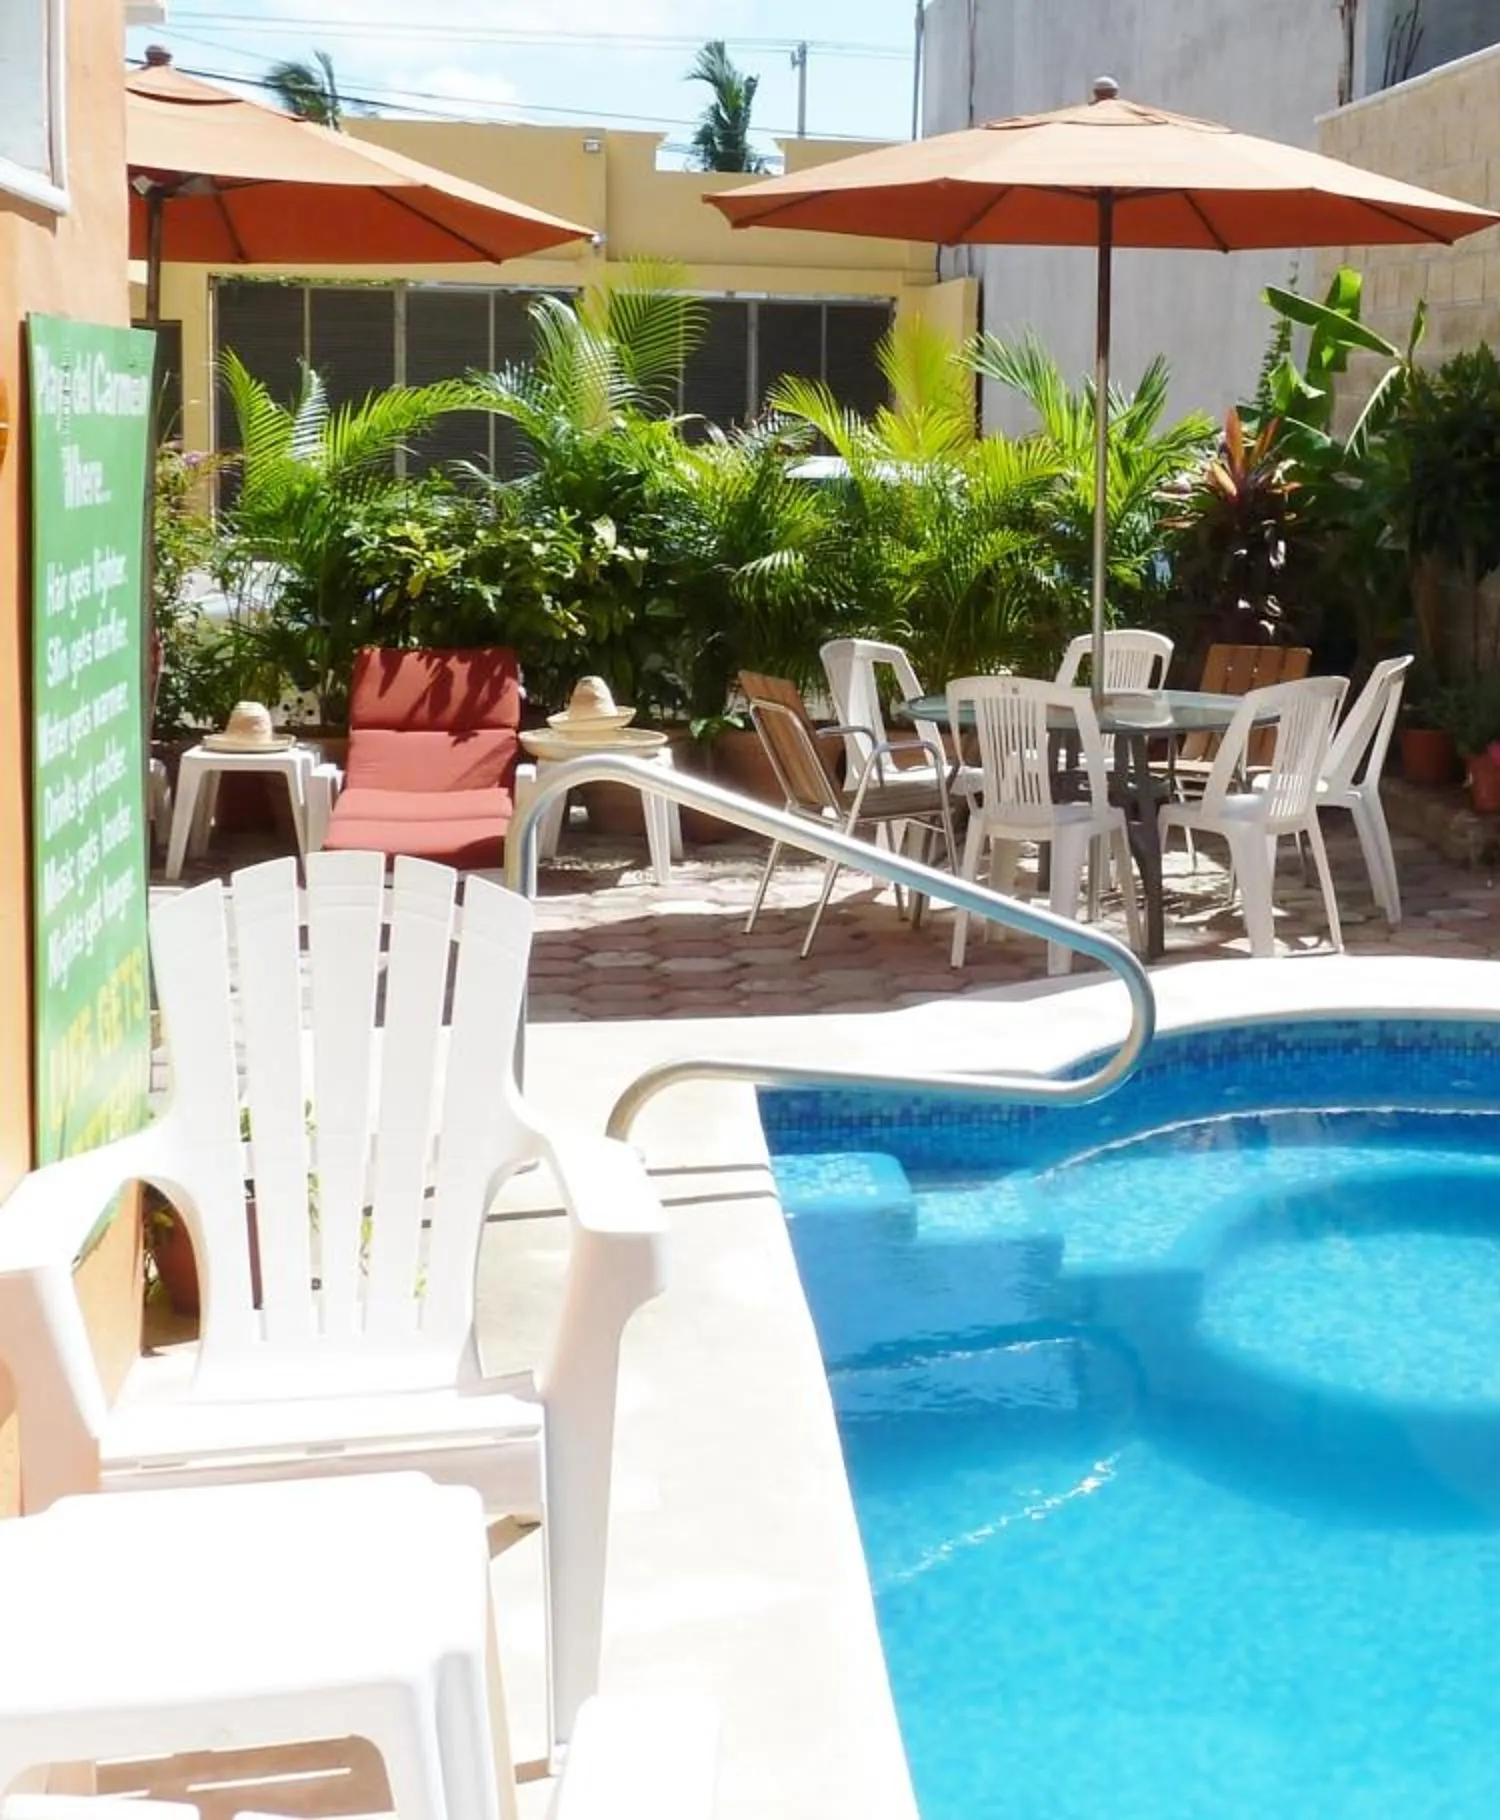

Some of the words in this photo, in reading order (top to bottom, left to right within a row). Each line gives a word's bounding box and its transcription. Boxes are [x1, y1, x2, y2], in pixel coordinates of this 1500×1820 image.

[46, 562, 68, 617] Hair
[69, 560, 92, 621] gets
[70, 626, 93, 690] gets
[69, 696, 92, 760] gets
[77, 762, 94, 826] get
[77, 825, 100, 897] gets
[84, 887, 104, 958] get
